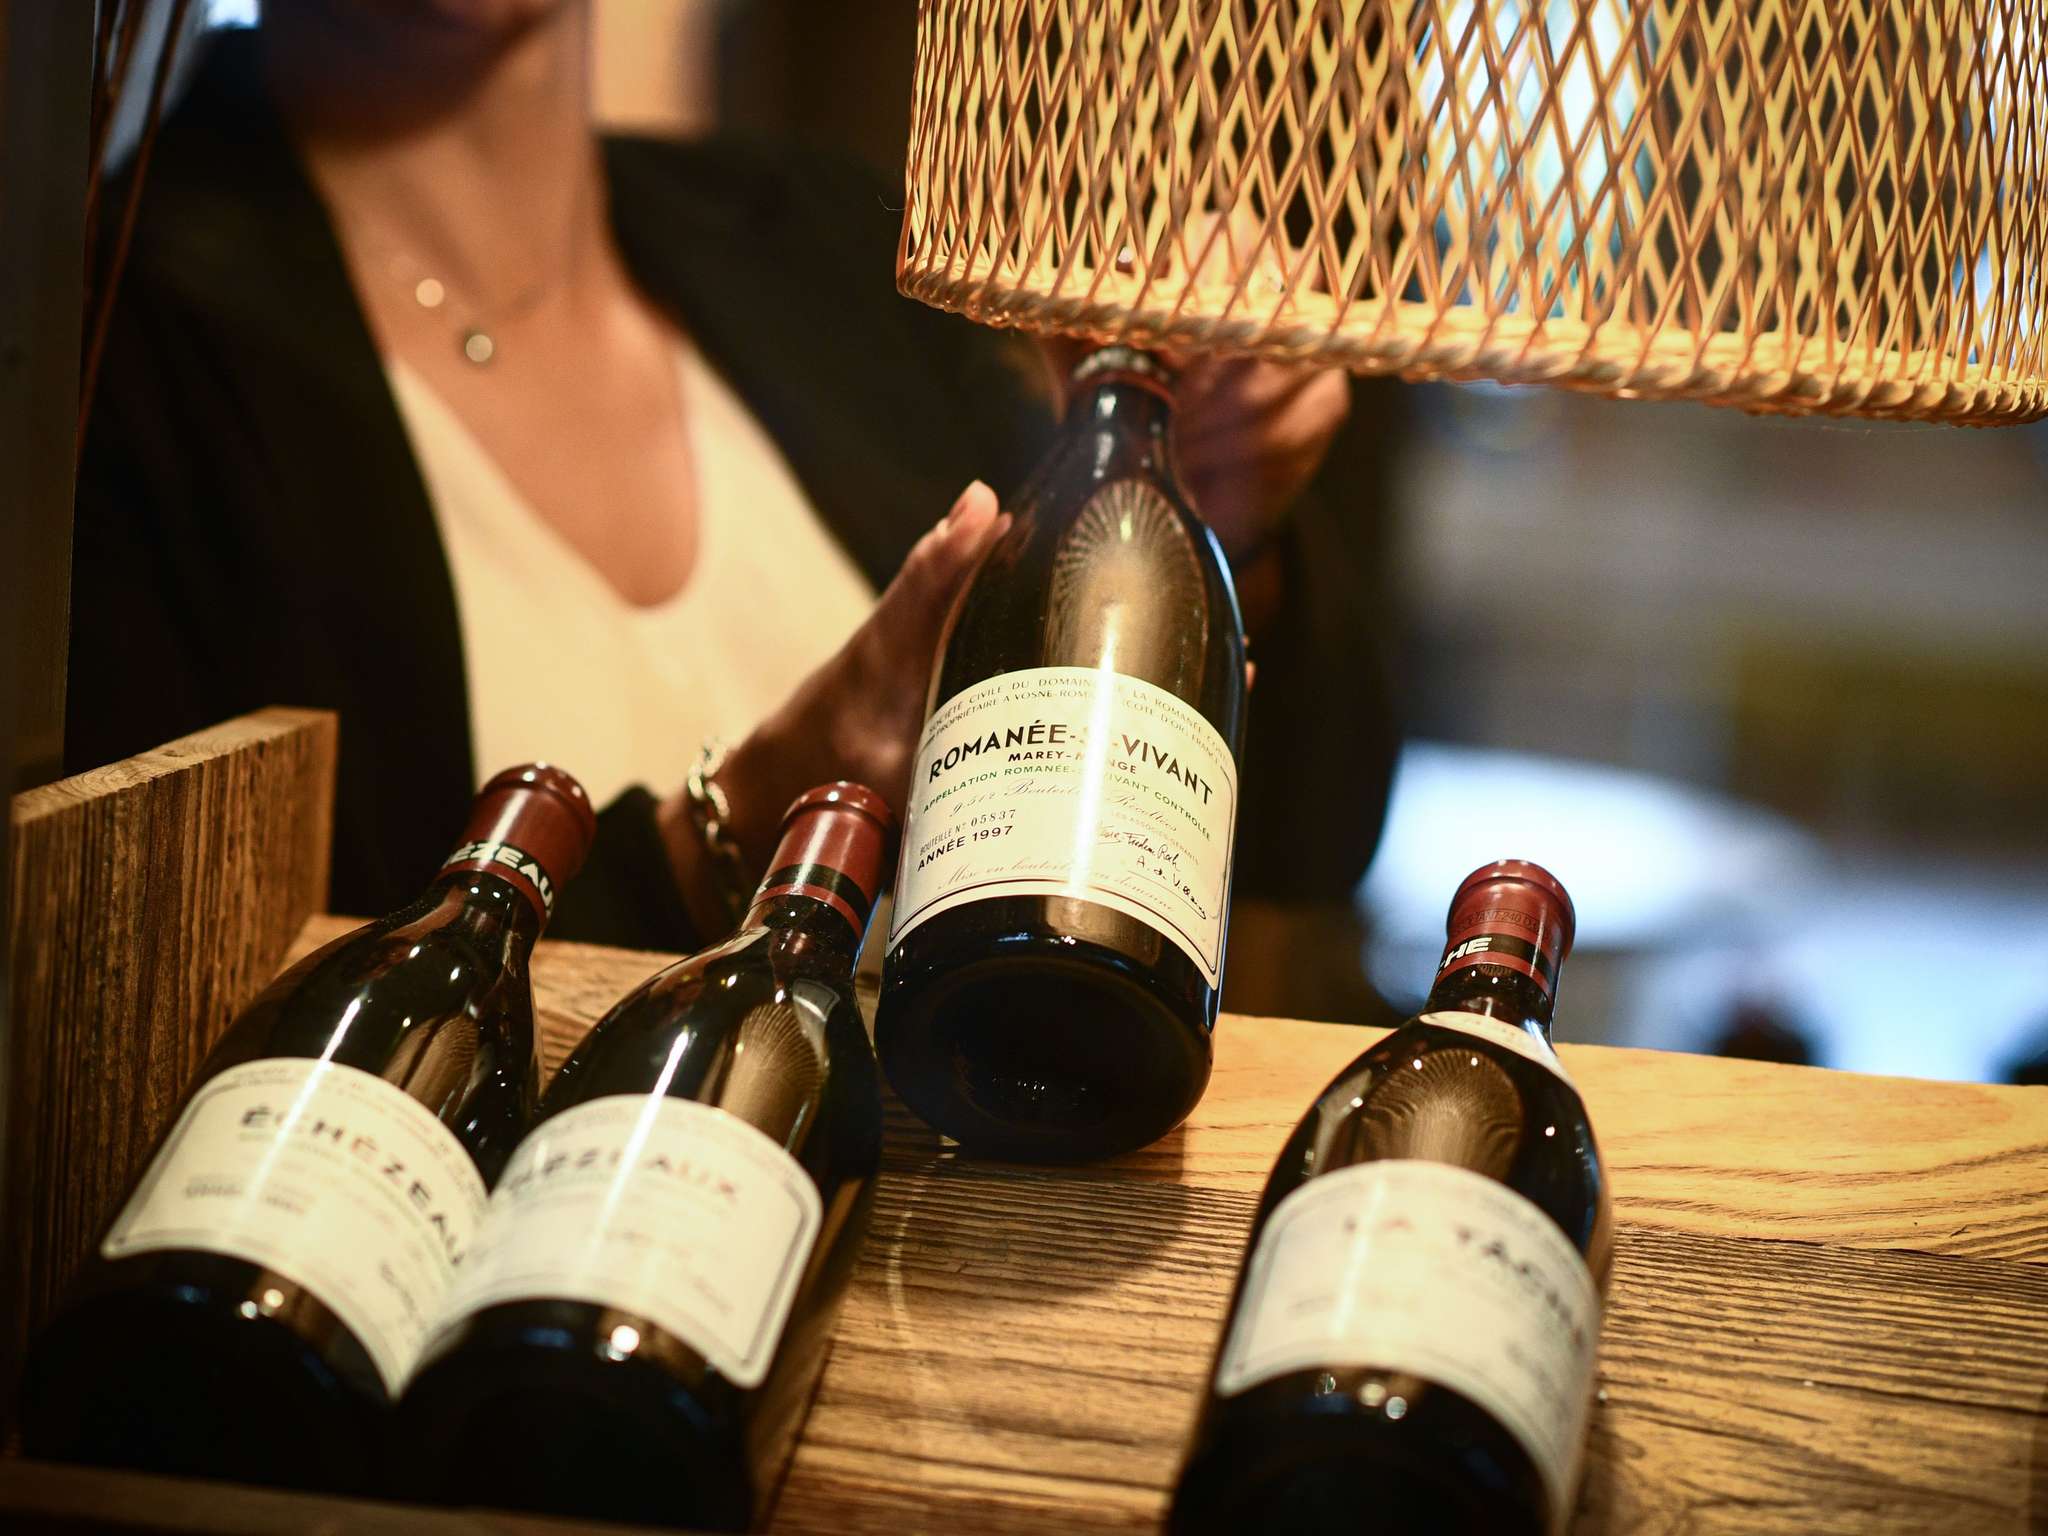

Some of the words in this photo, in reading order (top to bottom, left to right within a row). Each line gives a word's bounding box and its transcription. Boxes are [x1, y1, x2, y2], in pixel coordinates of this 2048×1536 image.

[1038, 678, 1092, 688] DOMAIN
[923, 771, 998, 814] APPELLATION
[970, 808, 1016, 828] 05837
[917, 835, 966, 873] ANNÉE
[972, 825, 1014, 843] 1997
[1435, 936, 1493, 976] HE
